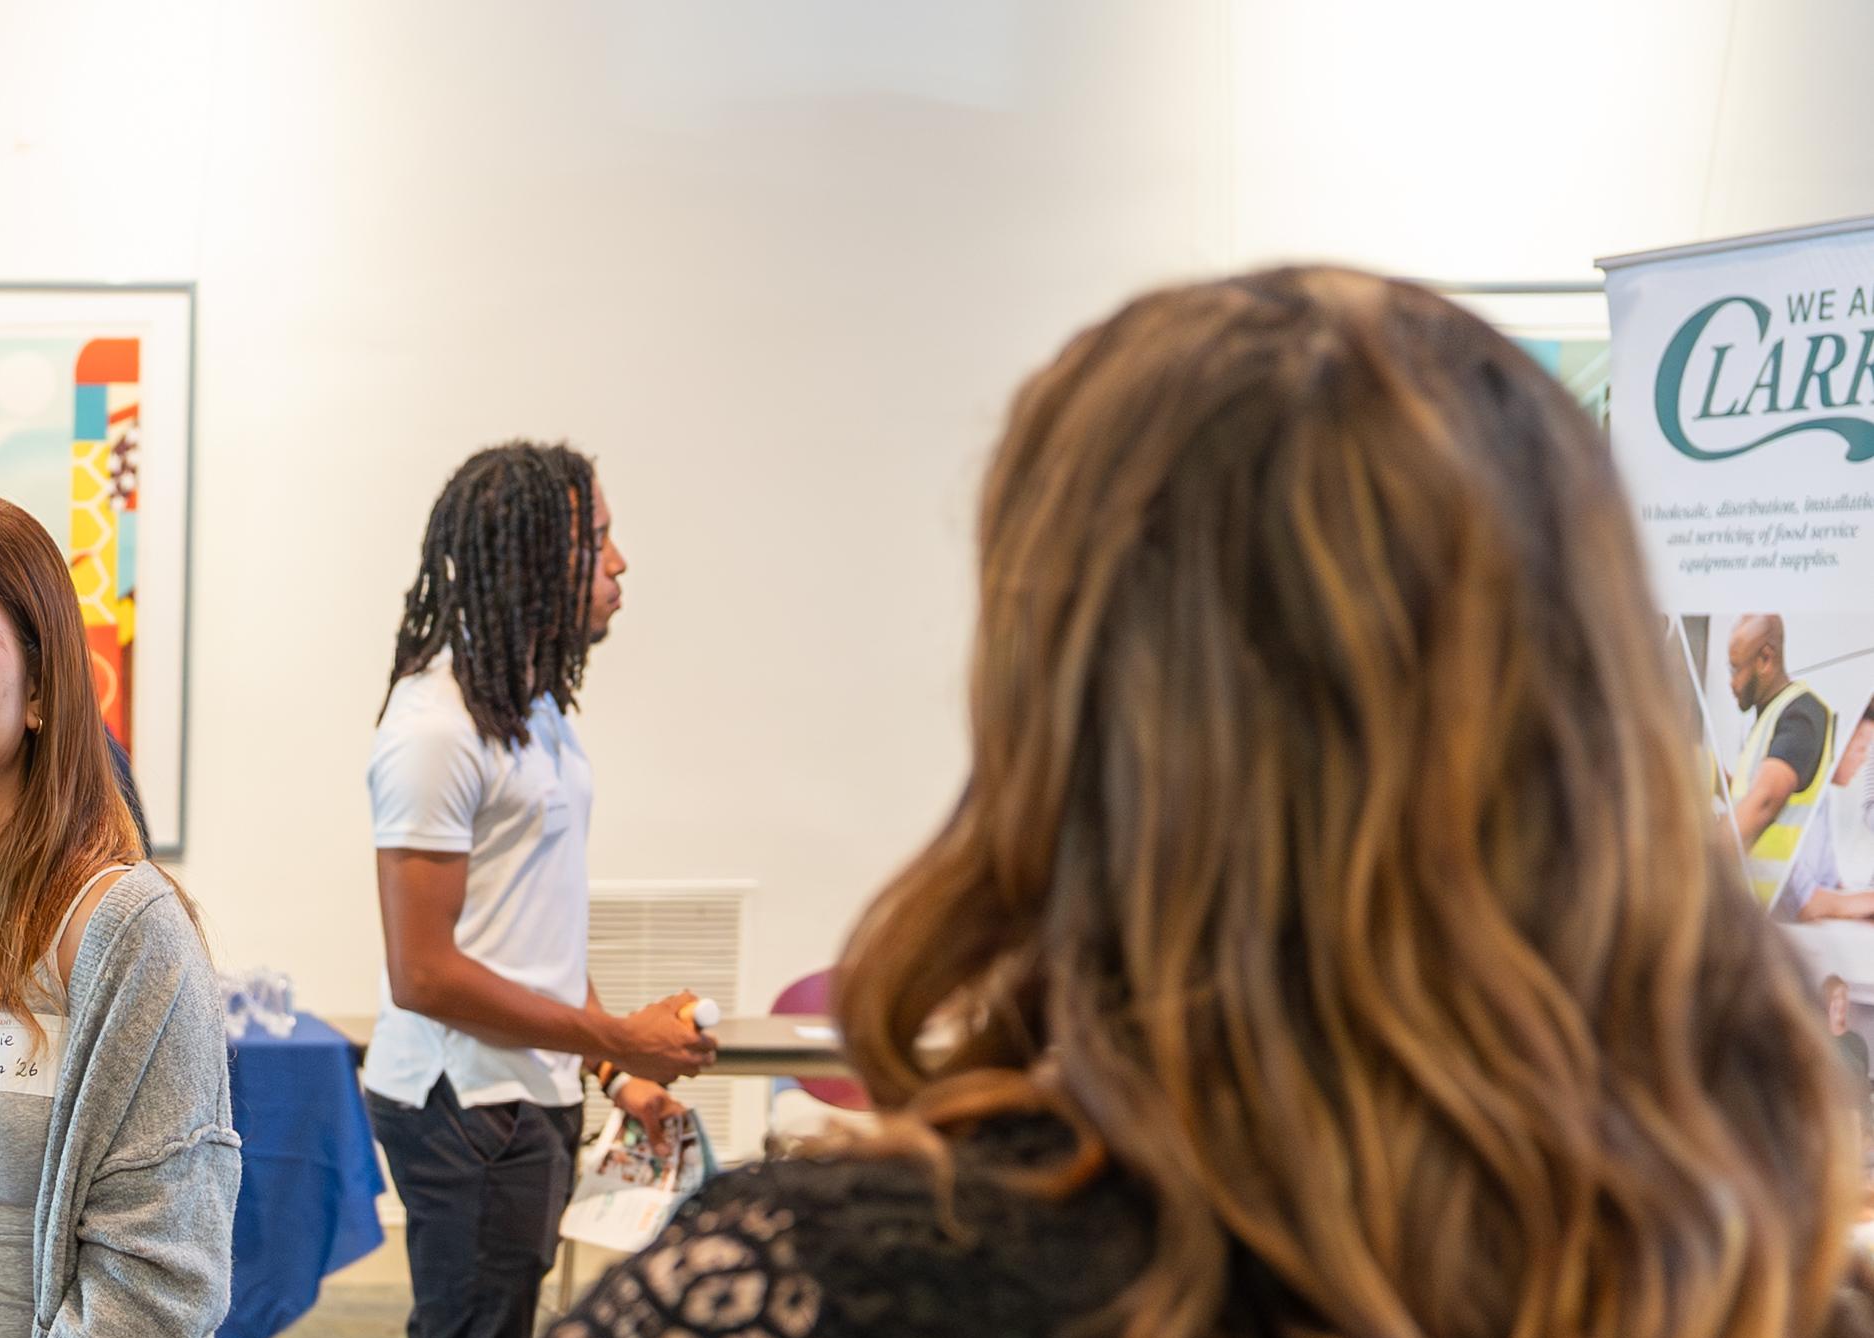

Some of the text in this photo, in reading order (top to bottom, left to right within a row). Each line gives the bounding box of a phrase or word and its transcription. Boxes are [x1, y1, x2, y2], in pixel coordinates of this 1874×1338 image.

[1787, 285, 1874, 323] WE A
[1667, 528, 1693, 546] and
[1750, 550, 1777, 569] and
